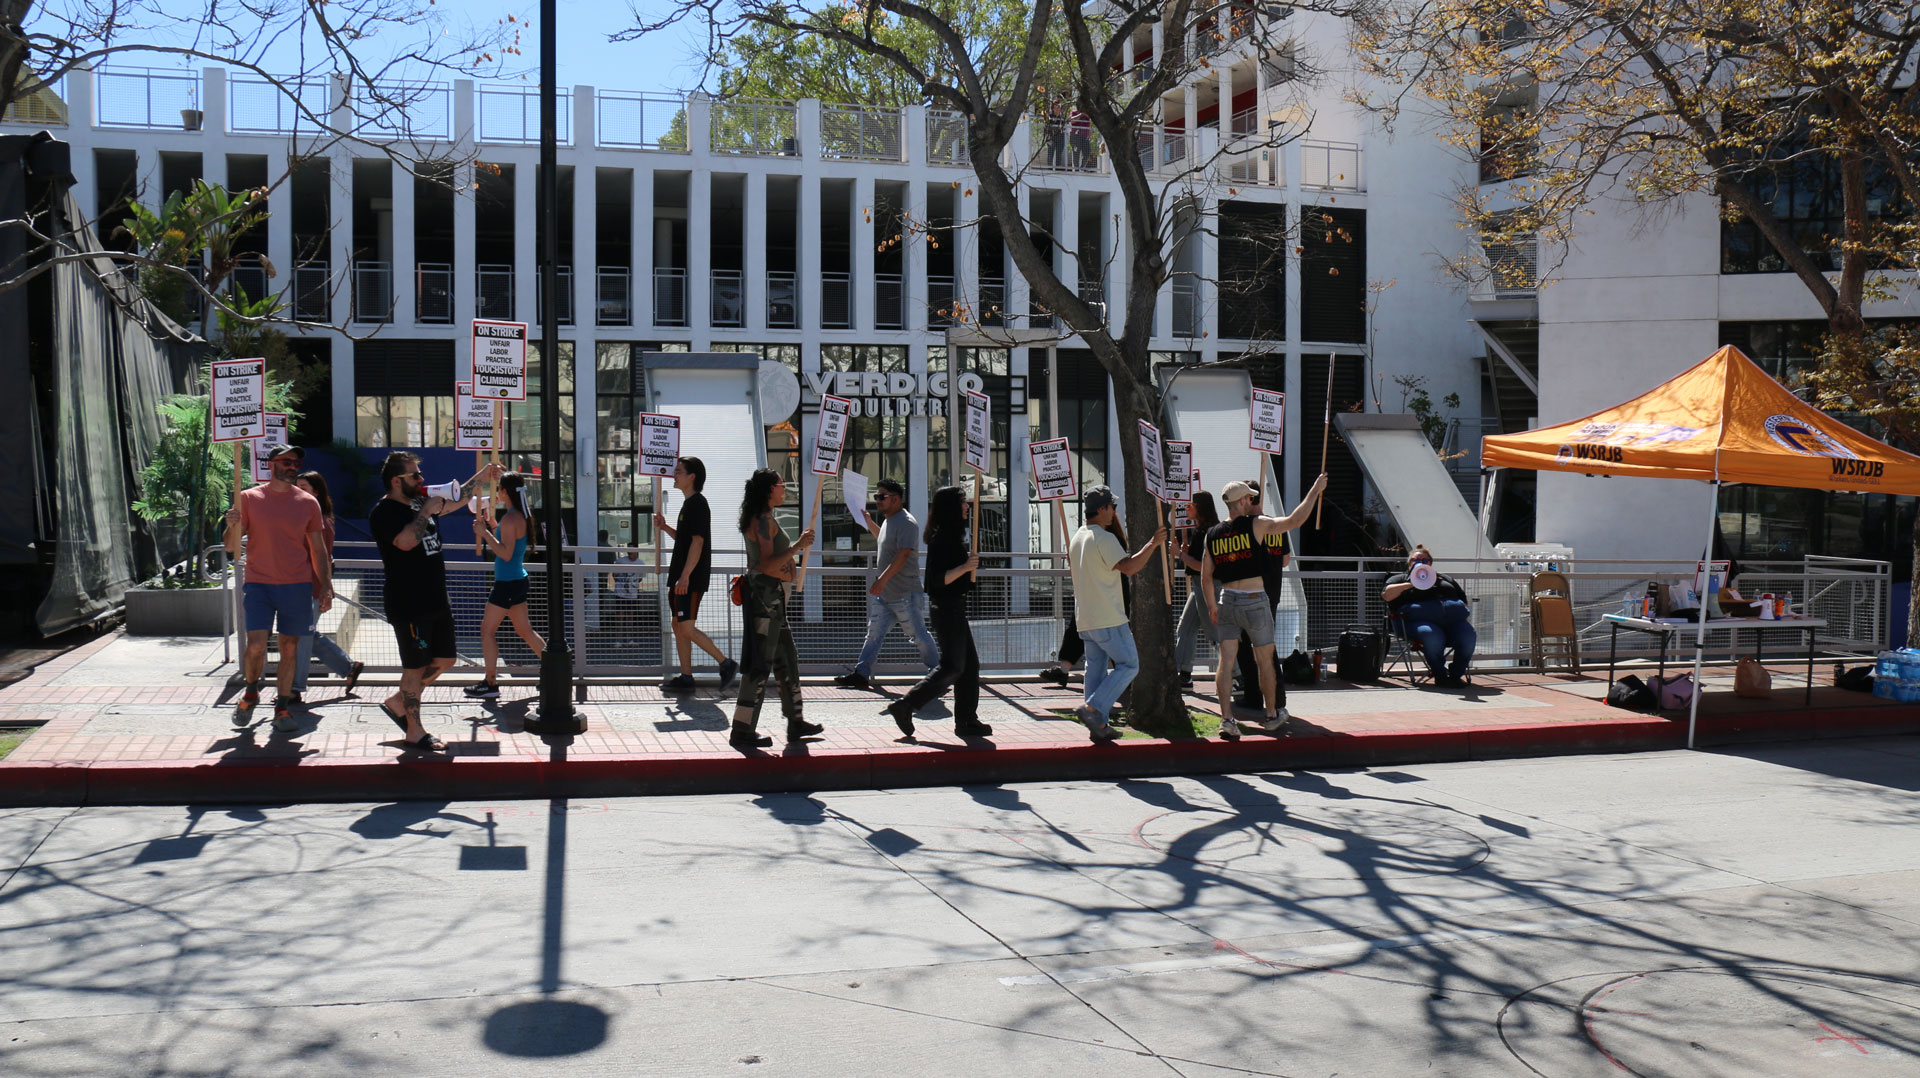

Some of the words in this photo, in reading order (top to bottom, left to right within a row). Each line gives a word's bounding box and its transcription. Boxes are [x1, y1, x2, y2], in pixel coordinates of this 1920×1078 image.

[478, 326, 489, 336] ON
[491, 327, 519, 338] STRIKE
[485, 356, 512, 364] PRACTICE
[217, 368, 229, 377] ON
[230, 365, 258, 376] STRIKE
[475, 365, 522, 376] TOUCHSTONE
[230, 378, 249, 386] UNFAIR
[480, 376, 517, 386] CLIMBING
[802, 371, 984, 397] VERDIGO
[460, 386, 471, 394] ON
[226, 395, 252, 403] PRACTICE
[1255, 392, 1263, 400] ON
[1263, 394, 1280, 404] STRIKE
[216, 404, 261, 416] TOUCHSTONE
[849, 397, 949, 418] OULDER
[222, 415, 256, 426] CLIMBING
[459, 420, 493, 428] TOUCHSTO
[654, 418, 675, 427] STRIKE
[1258, 416, 1275, 424] PRACTICE
[463, 428, 493, 437] CLIMBIN
[1253, 423, 1280, 433] TOUCHSTONE
[1255, 431, 1277, 442] CLIMBING
[642, 447, 677, 456] TOUCHSTONE
[1033, 445, 1042, 453] ON
[1042, 443, 1063, 452] STRIKE
[1168, 445, 1187, 453] STRIKE
[1577, 443, 1623, 462] WSRJB
[645, 456, 673, 466] CLIMBING
[1832, 458, 1884, 477] WSRJB
[1038, 471, 1071, 482] TOUCHSTONE
[1042, 479, 1068, 489] CLIMBING
[1212, 533, 1251, 556] UNION
[1264, 533, 1283, 547] ION
